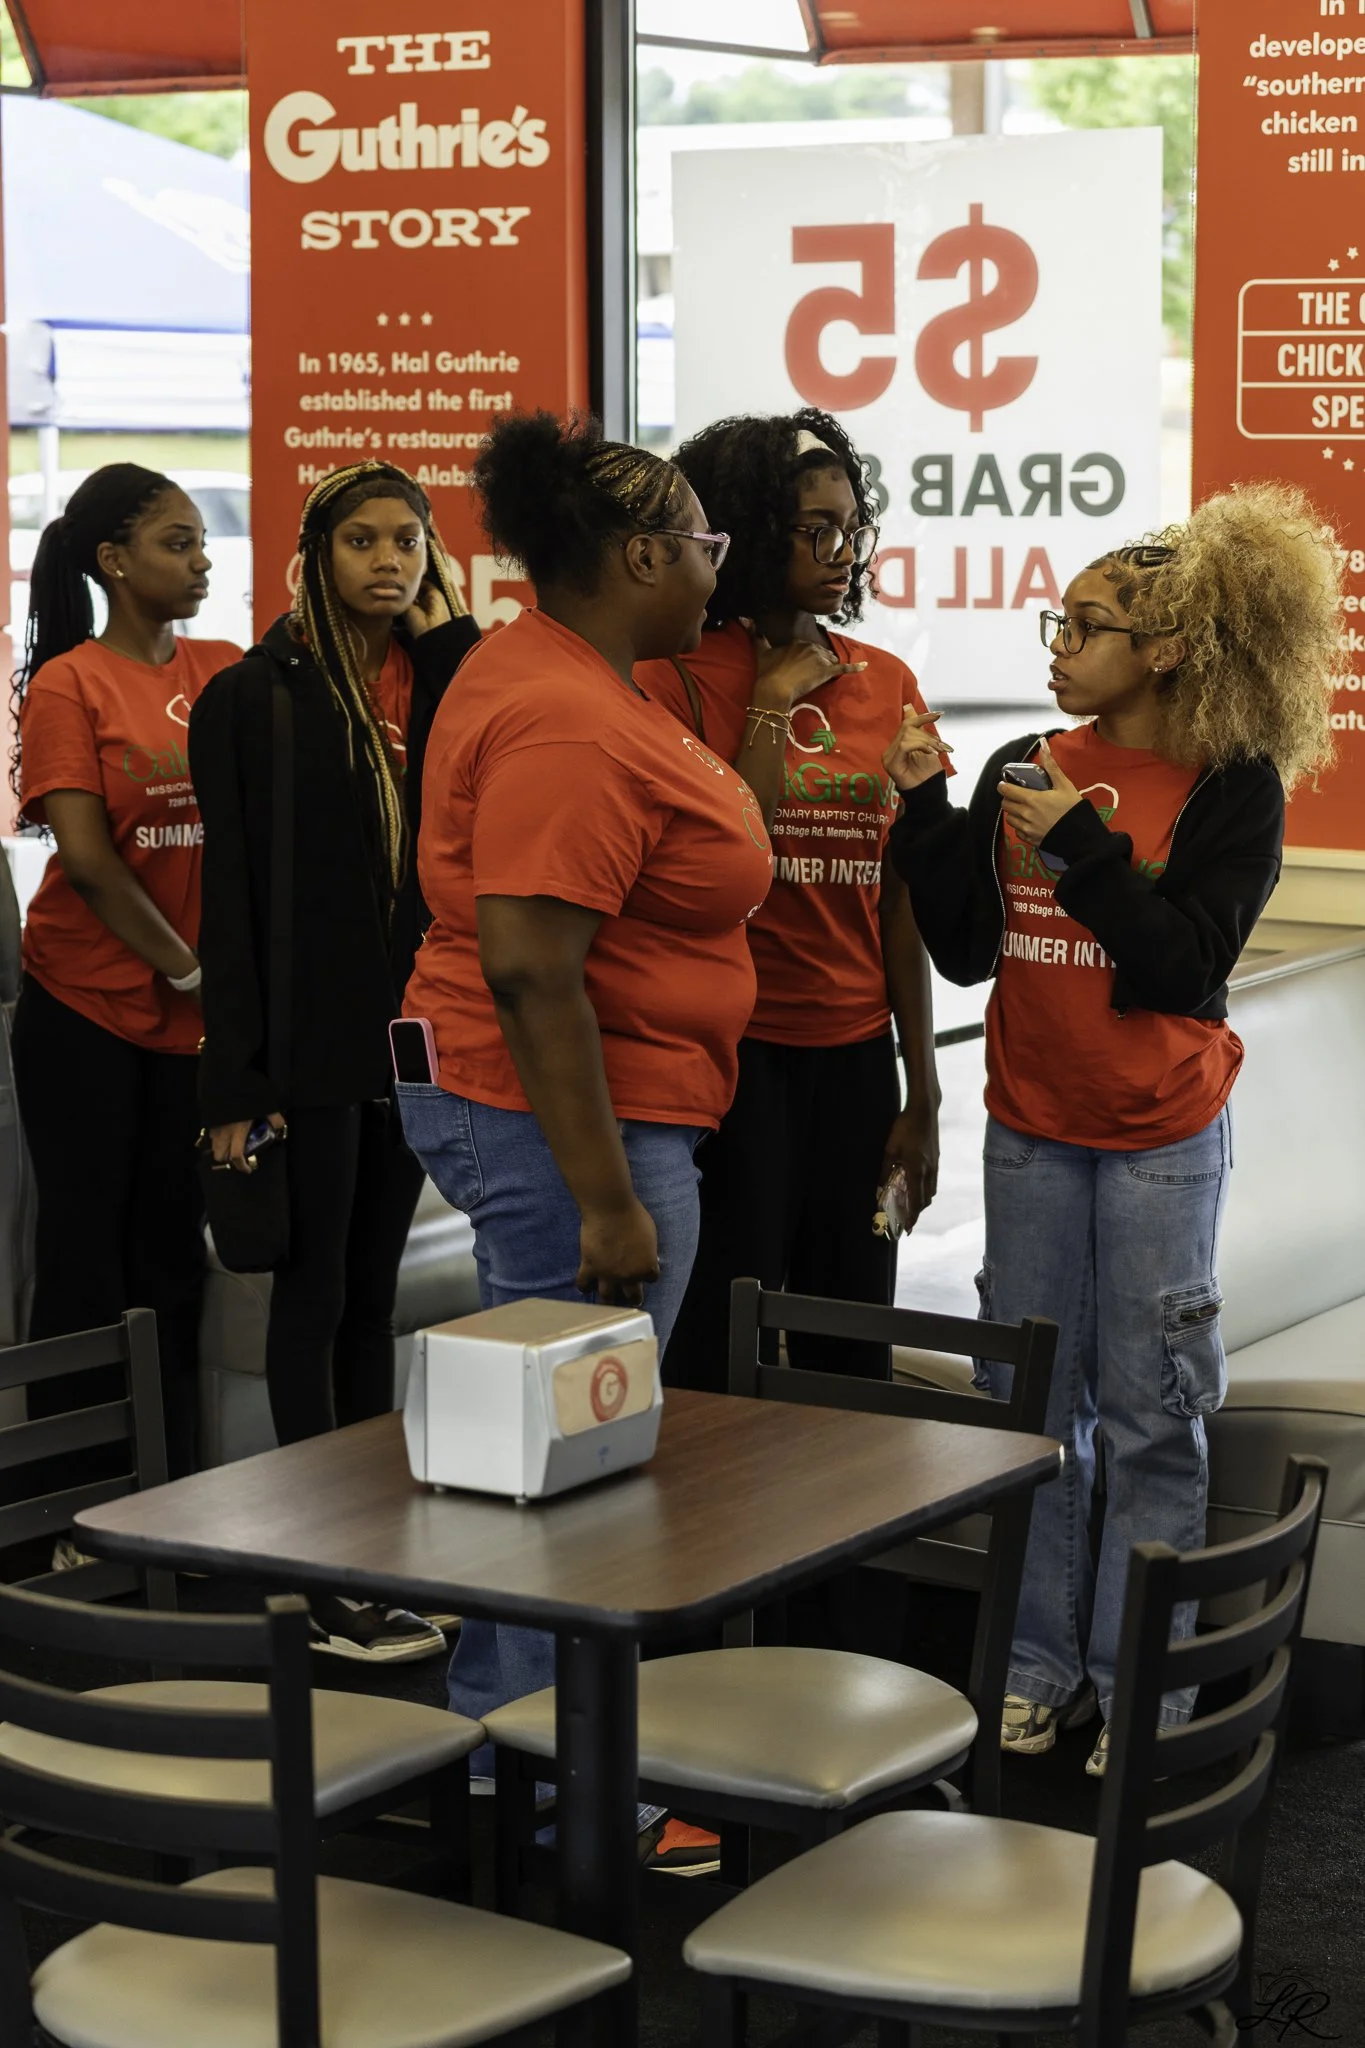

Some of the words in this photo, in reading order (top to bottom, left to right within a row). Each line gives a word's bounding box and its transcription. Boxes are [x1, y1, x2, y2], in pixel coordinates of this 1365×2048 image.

[336, 30, 490, 75] THE
[1260, 109, 1358, 136] chicken
[263, 90, 550, 184] Guthrie's
[1287, 148, 1333, 174] still
[301, 206, 531, 250] STORY
[1298, 291, 1350, 325] THE
[299, 352, 321, 374] In
[327, 352, 386, 377] 1965,
[391, 351, 429, 373] Hal
[435, 350, 520, 373] Guthrie
[1277, 343, 1365, 377] CHICK
[300, 388, 422, 411] established
[427, 388, 463, 411] the
[468, 388, 513, 411] first
[1311, 395, 1365, 428] SPE
[387, 430, 492, 449] restaura
[813, 810, 856, 821] BAPTIST
[785, 825, 810, 837] Stage
[811, 826, 825, 837] Rd.
[826, 827, 865, 840] Memphis,
[1028, 903, 1053, 918] Stage
